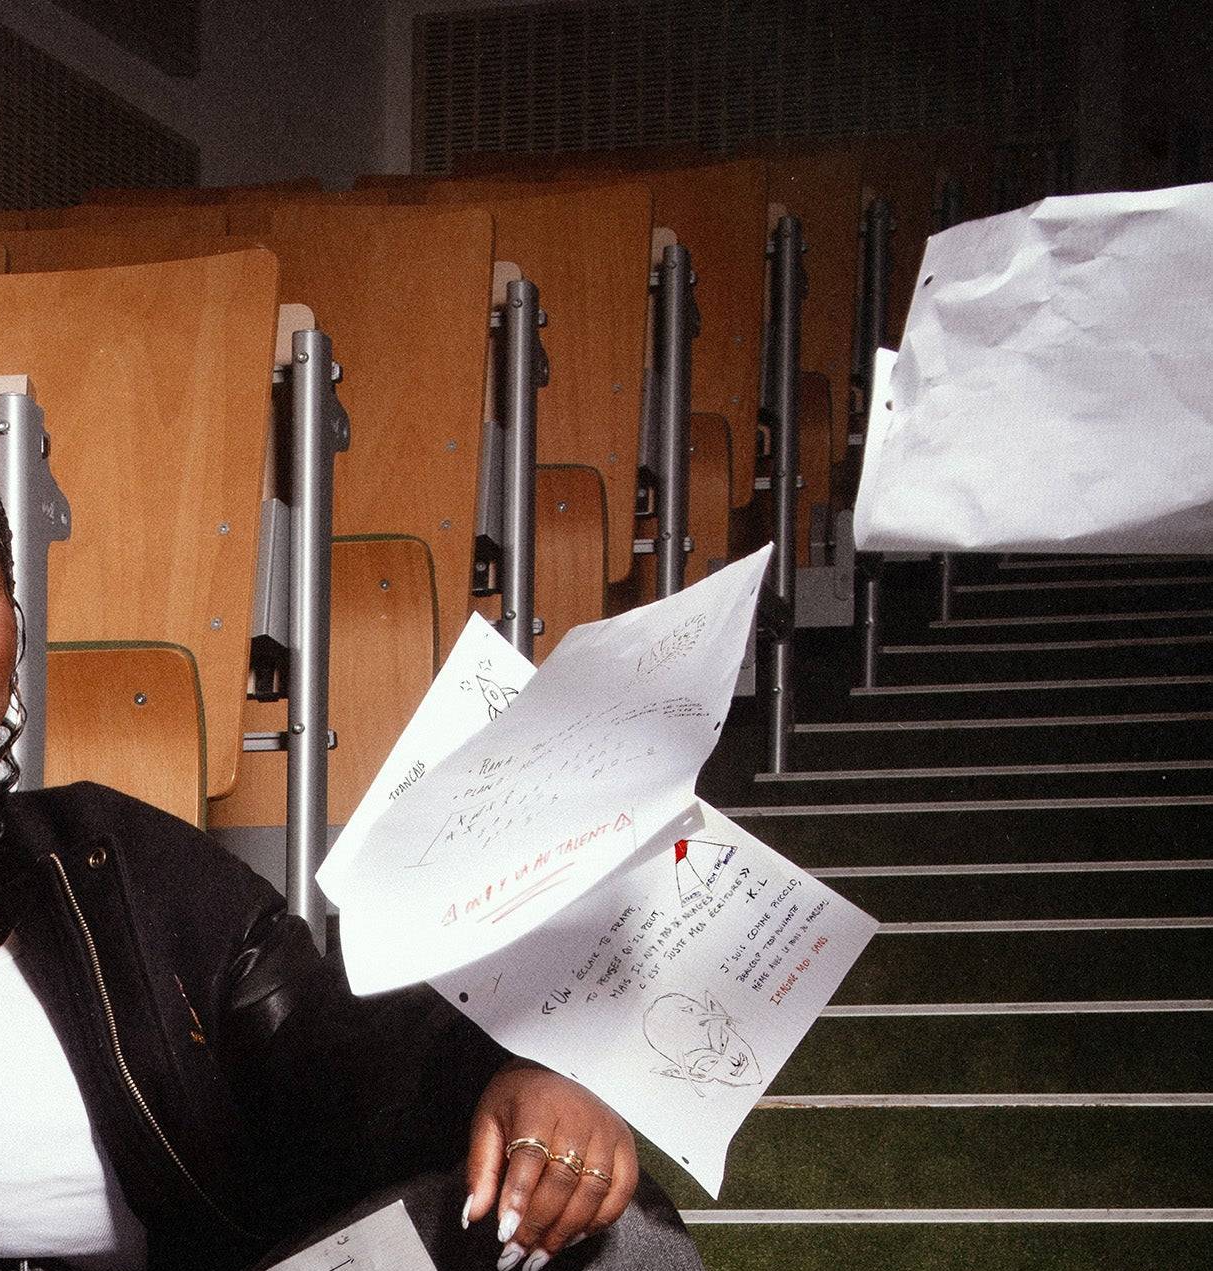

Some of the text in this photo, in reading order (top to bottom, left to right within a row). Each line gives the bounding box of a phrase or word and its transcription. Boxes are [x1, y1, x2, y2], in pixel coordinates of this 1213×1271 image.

[556, 823, 611, 856] TALENT
[747, 912, 771, 941] COMME
[609, 978, 632, 999] MAIS
